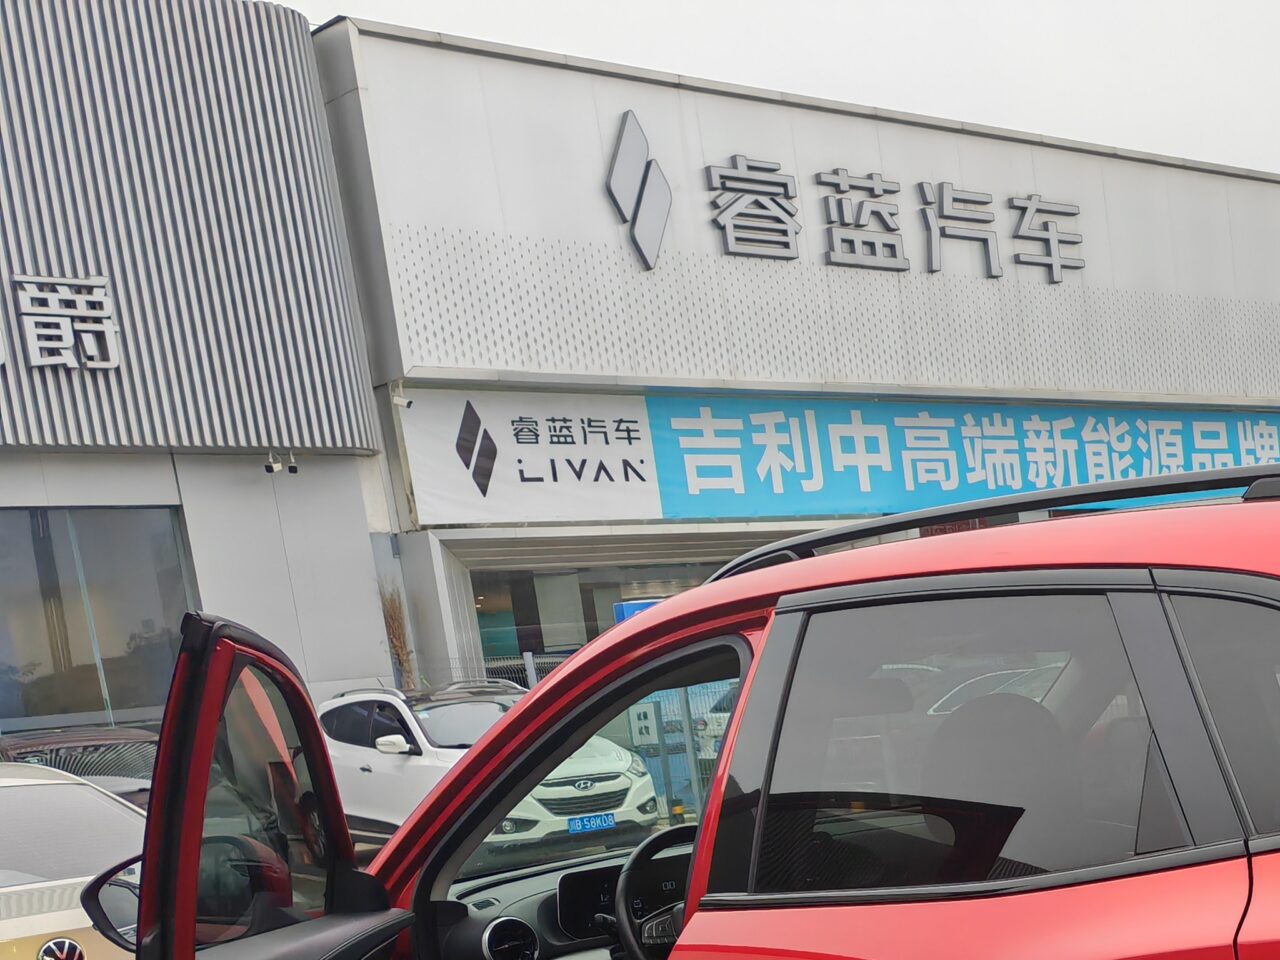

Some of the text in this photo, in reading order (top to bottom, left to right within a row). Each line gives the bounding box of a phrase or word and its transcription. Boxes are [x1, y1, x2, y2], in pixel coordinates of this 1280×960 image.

[705, 153, 1086, 284] 睿蓝汽车
[511, 416, 641, 446] 睿蓝汽车
[516, 458, 648, 483] LIVAN
